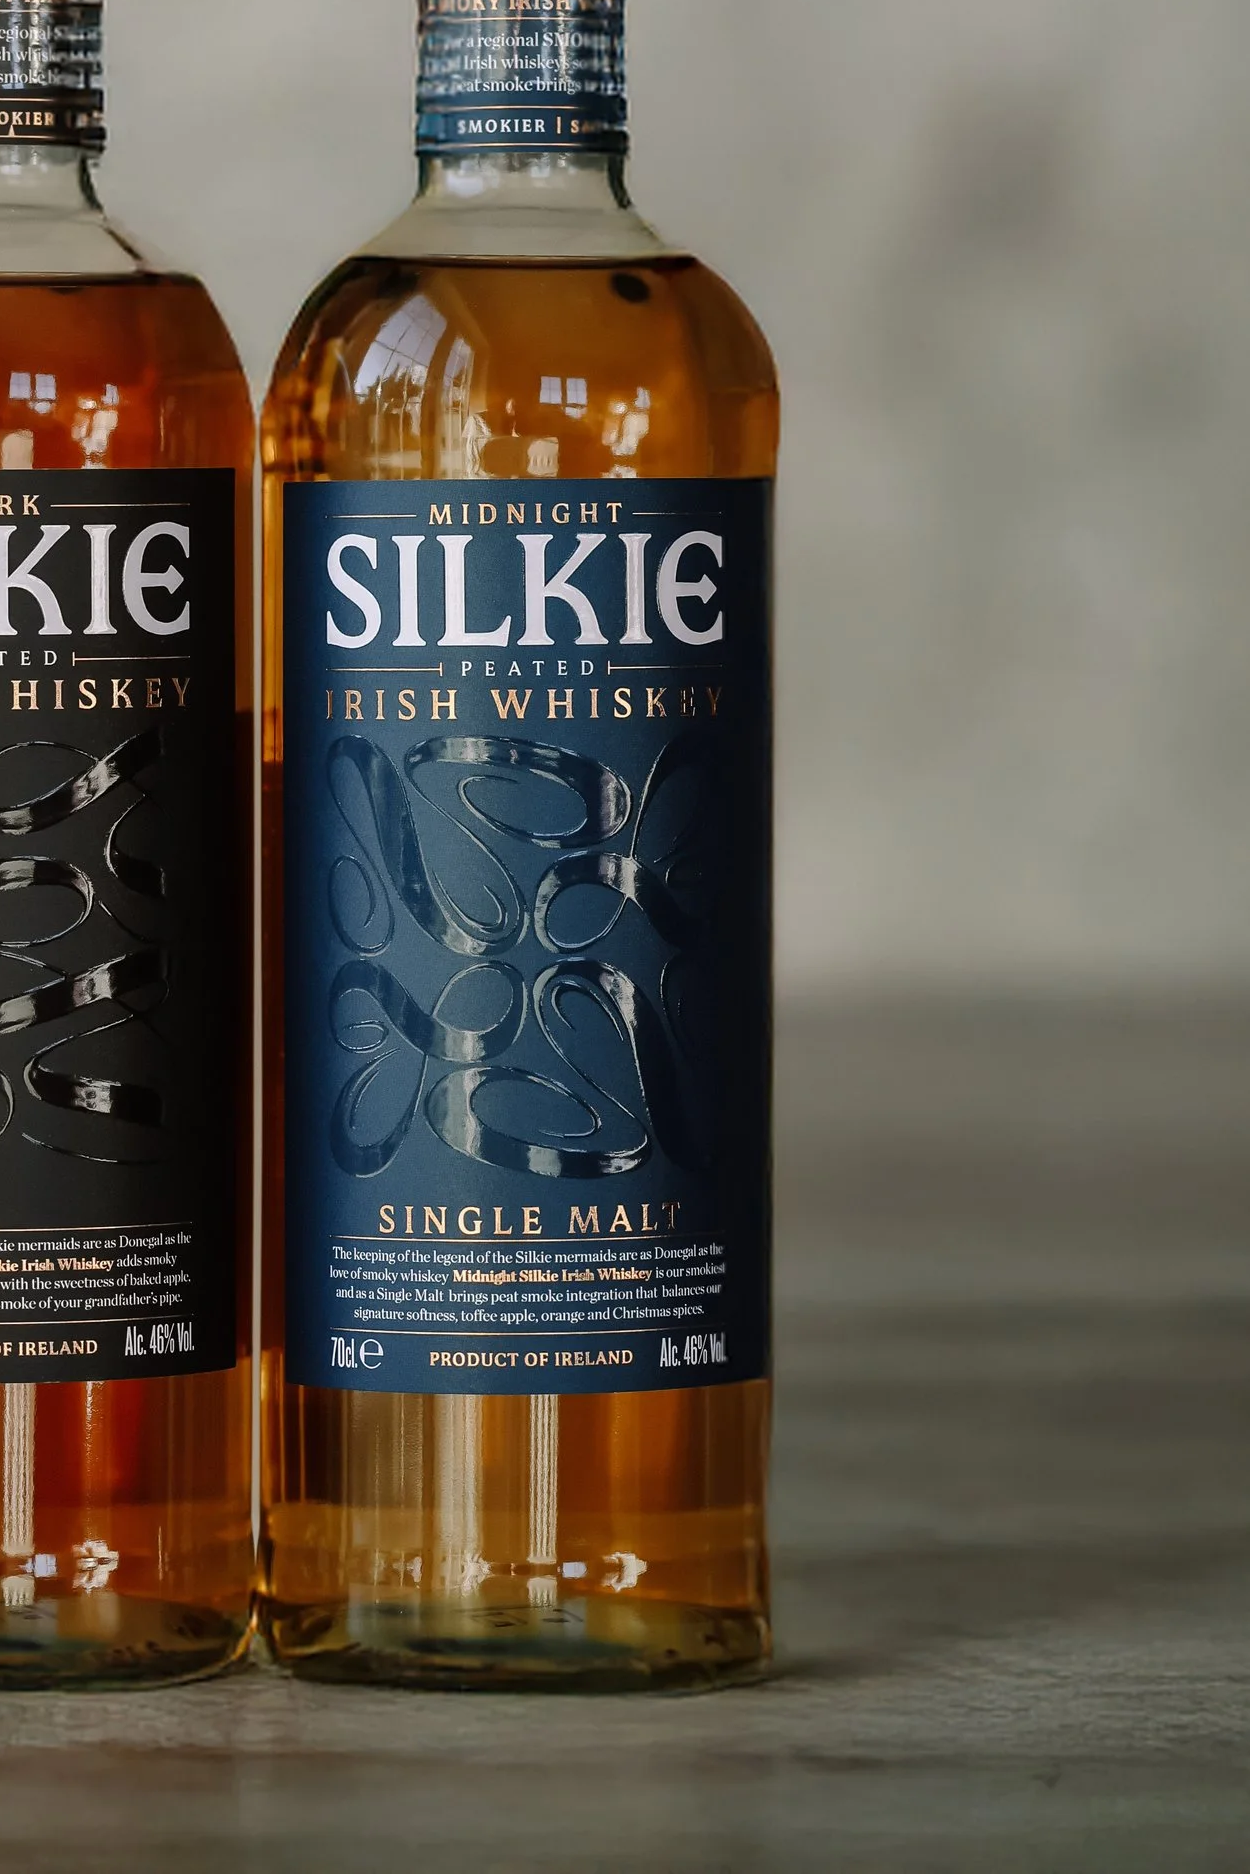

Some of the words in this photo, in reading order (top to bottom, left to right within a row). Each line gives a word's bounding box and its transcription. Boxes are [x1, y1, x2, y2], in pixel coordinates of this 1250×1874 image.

[477, 32, 539, 50] regional
[464, 55, 497, 70] Irish
[483, 77, 533, 92] smoke
[457, 118, 546, 134] SMOKIER
[428, 502, 624, 526] MIDNIGHT
[326, 530, 724, 649] SILKIE
[461, 660, 596, 677] PEATED
[326, 689, 458, 721] IRISH
[490, 686, 723, 720] WHISKEY
[379, 1204, 542, 1235] SINGLE
[568, 1201, 681, 1234] MALT
[18, 1237, 81, 1252] mermaids
[83, 1240, 102, 1250] are
[104, 1238, 116, 1249] as
[119, 1233, 163, 1250] Donegal
[165, 1236, 175, 1245] as
[177, 1231, 192, 1244] the
[22, 1259, 55, 1271] Irish
[57, 1257, 114, 1272] Whiskey
[116, 1254, 143, 1268] adds
[144, 1252, 177, 1267] smoky
[0, 1277, 29, 1290] with
[31, 1276, 52, 1290] the
[54, 1276, 115, 1289] sweetness
[116, 1274, 130, 1287] of
[130, 1272, 162, 1286] baked
[163, 1270, 191, 1284] apple.
[330, 1265, 349, 1279] love
[350, 1268, 363, 1279] of
[363, 1268, 398, 1284] smoky
[400, 1269, 449, 1285] whiskey
[453, 1269, 517, 1285] Midnight
[518, 1269, 559, 1282] Silkie
[562, 1268, 595, 1282] Irish
[597, 1267, 653, 1282] Whiskey
[655, 1266, 664, 1279] is
[666, 1267, 684, 1278] our
[39, 1296, 52, 1309] of
[54, 1300, 82, 1311] your
[160, 1291, 183, 1306] pipe.
[354, 1306, 404, 1321] signature
[406, 1308, 458, 1324] softness,
[461, 1309, 498, 1322] toffee
[500, 1309, 539, 1325] apple,
[541, 1310, 585, 1324] orange
[588, 1306, 610, 1320] and
[613, 1306, 672, 1320] Christmas
[673, 1303, 704, 1319] spices.
[18, 1340, 98, 1356] IRELAND
[124, 1326, 147, 1356] Alc.
[150, 1324, 175, 1354] 46%
[177, 1321, 194, 1352] Vol.
[330, 1336, 358, 1369] 70cl.
[429, 1351, 519, 1368] PRODUCT
[524, 1352, 549, 1368] OF
[554, 1350, 634, 1367] IRELAND
[660, 1337, 681, 1368] Alc.
[684, 1334, 708, 1366] 46%
